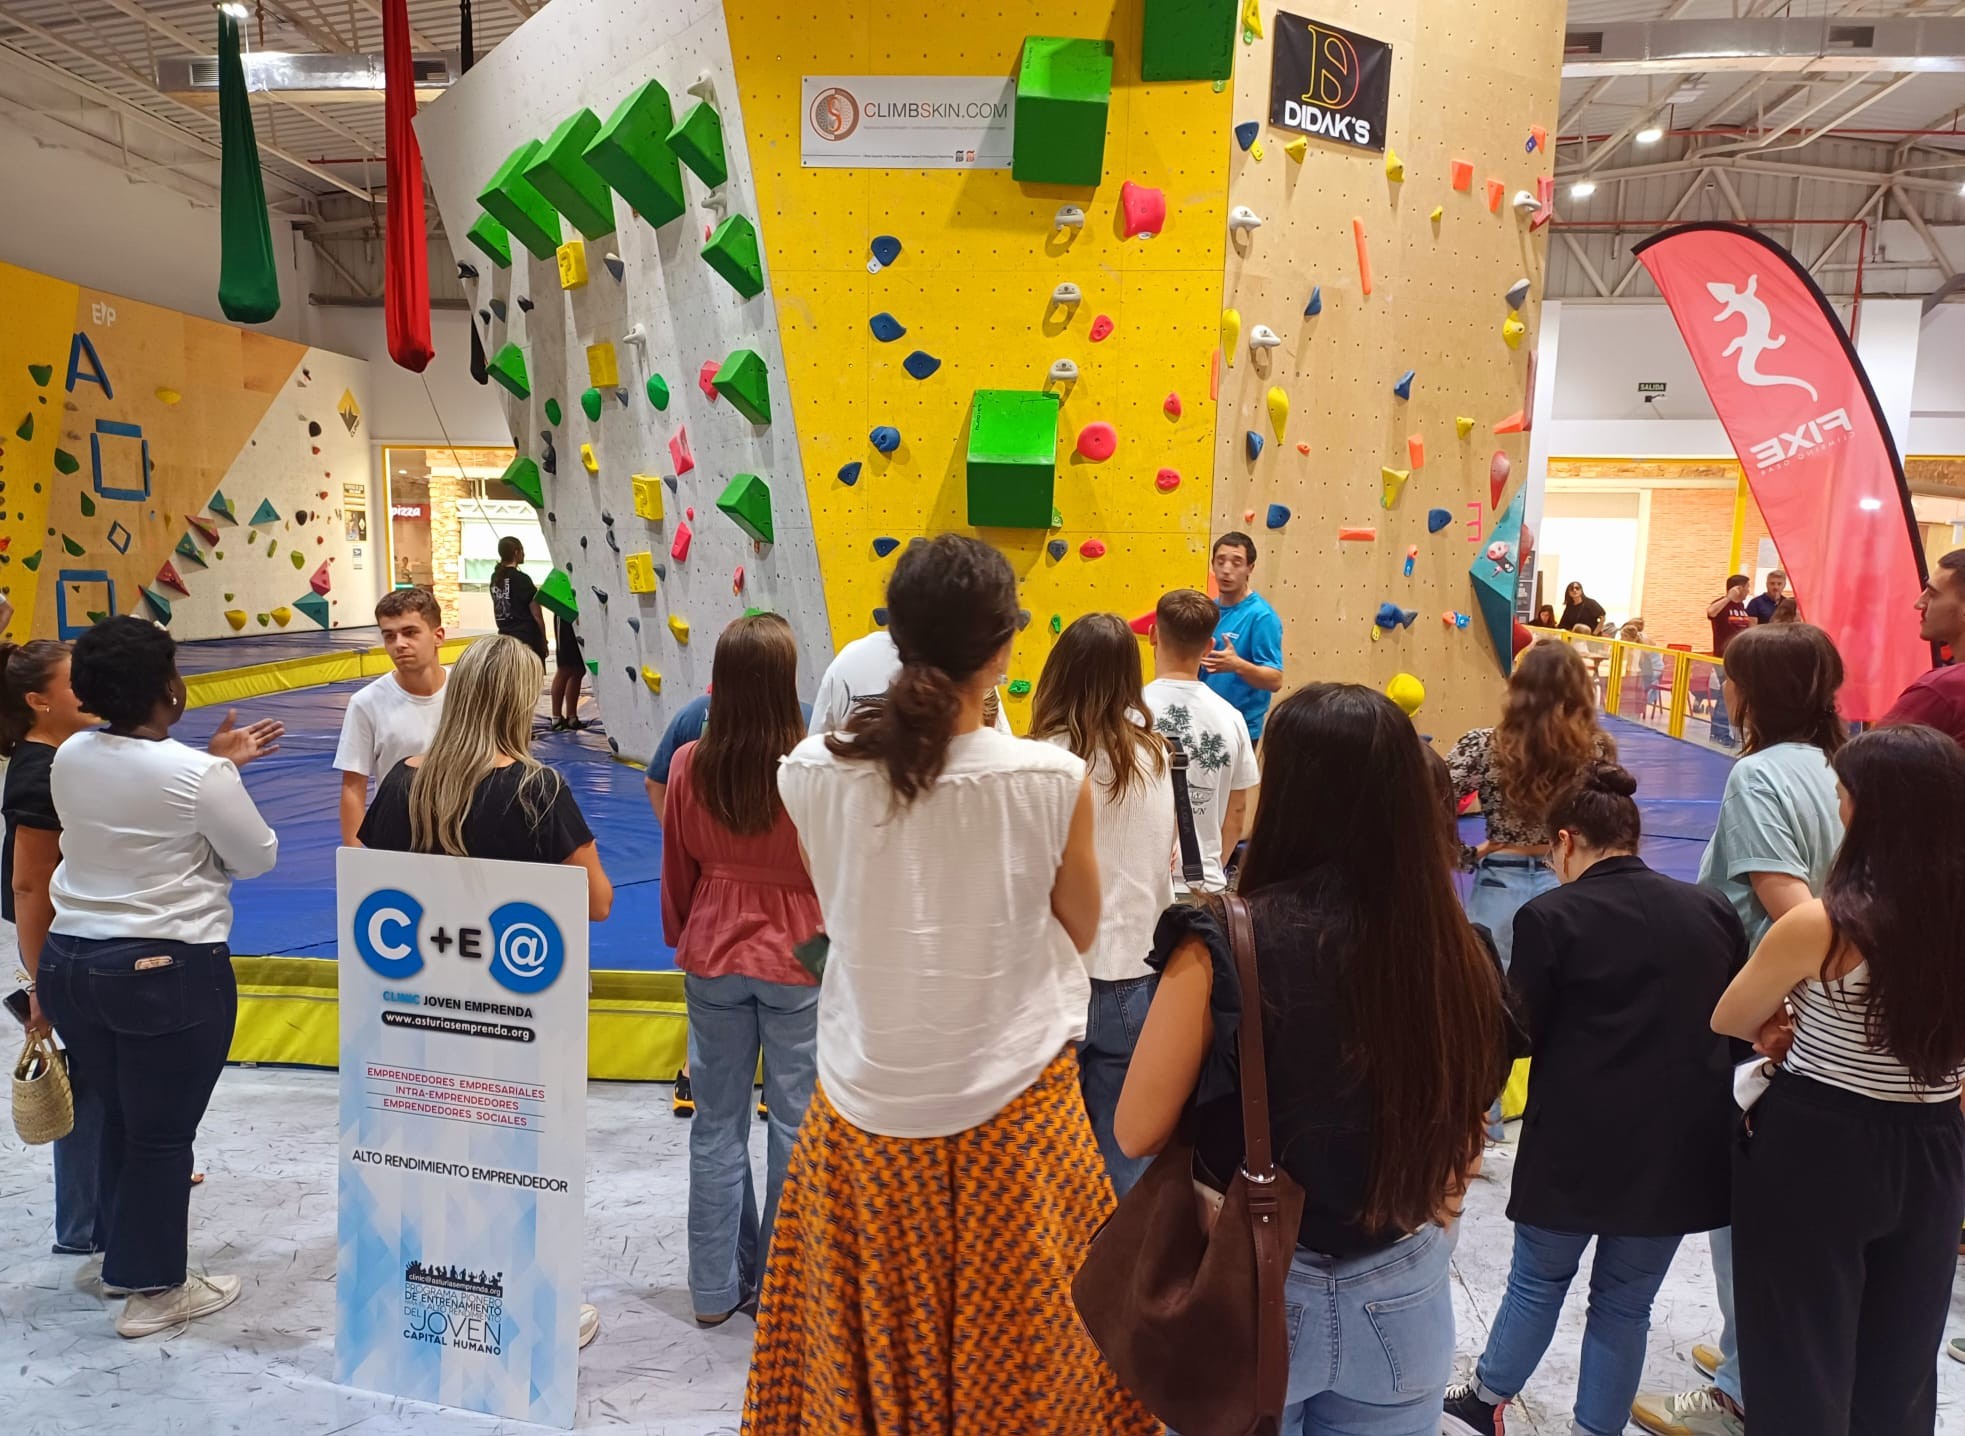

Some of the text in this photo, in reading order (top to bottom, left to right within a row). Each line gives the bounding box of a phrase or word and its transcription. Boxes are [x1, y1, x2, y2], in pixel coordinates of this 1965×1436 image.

[864, 102, 1008, 119] CLIMBSKIN.COM
[1284, 100, 1371, 144] DIDAK'S
[391, 504, 421, 517] pizza
[423, 995, 461, 1011] JOVEN
[464, 1000, 534, 1019] EMPRENDA
[385, 1013, 531, 1042] www.asturiasemprenda.org
[367, 1067, 546, 1099] EMPRENDEDORES EMPRESARIALES
[395, 1085, 520, 1111] INTRA-EMPRENDEDORES
[383, 1098, 528, 1126] EMPRENDEDORES SOCIALES
[352, 1149, 569, 1193] ALTO RENDIMIENTO EMPRENDEDOR
[405, 1282, 503, 1309] PROGRAMA PIONERO
[408, 1272, 502, 1296] clinic@asturiasemprenda.org
[404, 1291, 418, 1301] DE
[421, 1293, 502, 1316] ENTRENAMIENTO
[404, 1305, 502, 1346] DEL JOVEN
[403, 1329, 502, 1356] CAPITAL HUMANO
